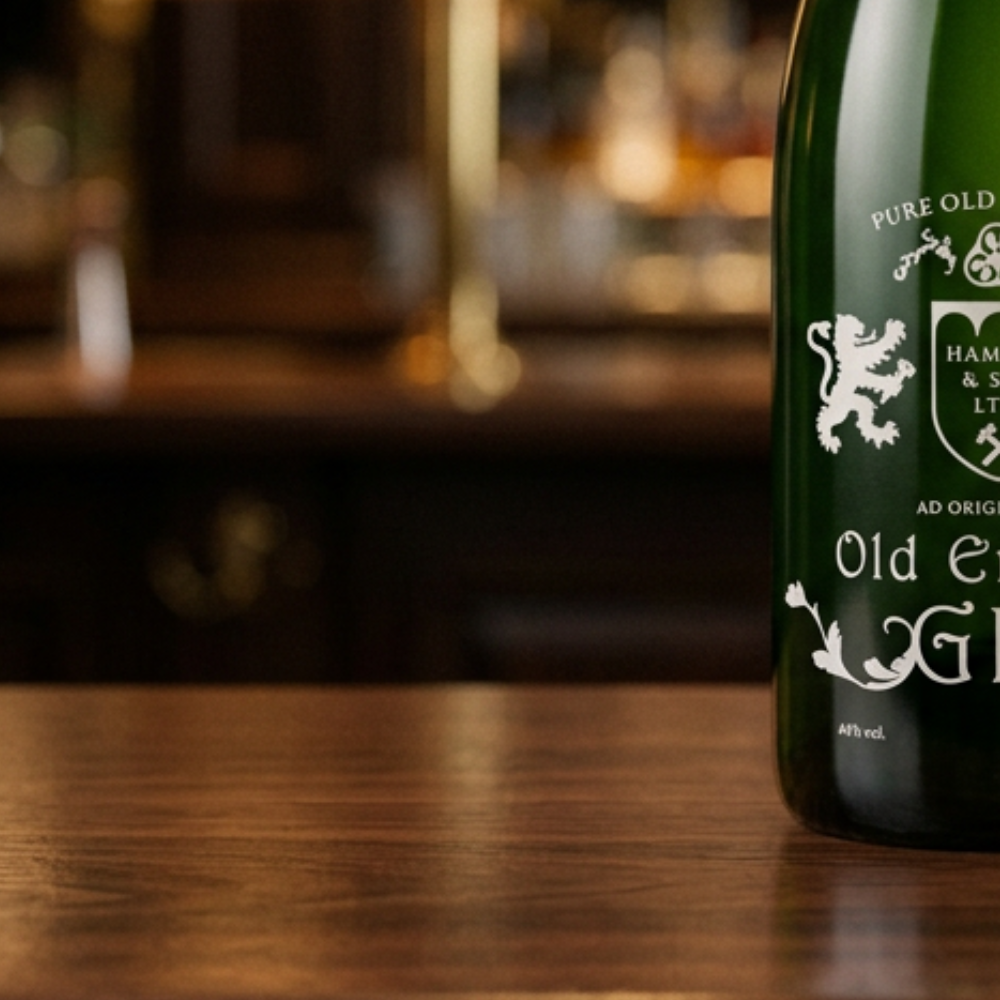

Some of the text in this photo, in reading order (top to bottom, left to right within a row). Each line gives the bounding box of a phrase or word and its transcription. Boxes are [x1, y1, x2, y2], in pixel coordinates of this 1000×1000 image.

[871, 197, 934, 230] PURE
[940, 191, 995, 212] OLD
[962, 372, 979, 388] &
[916, 501, 942, 515] AD
[836, 530, 918, 581] Old
